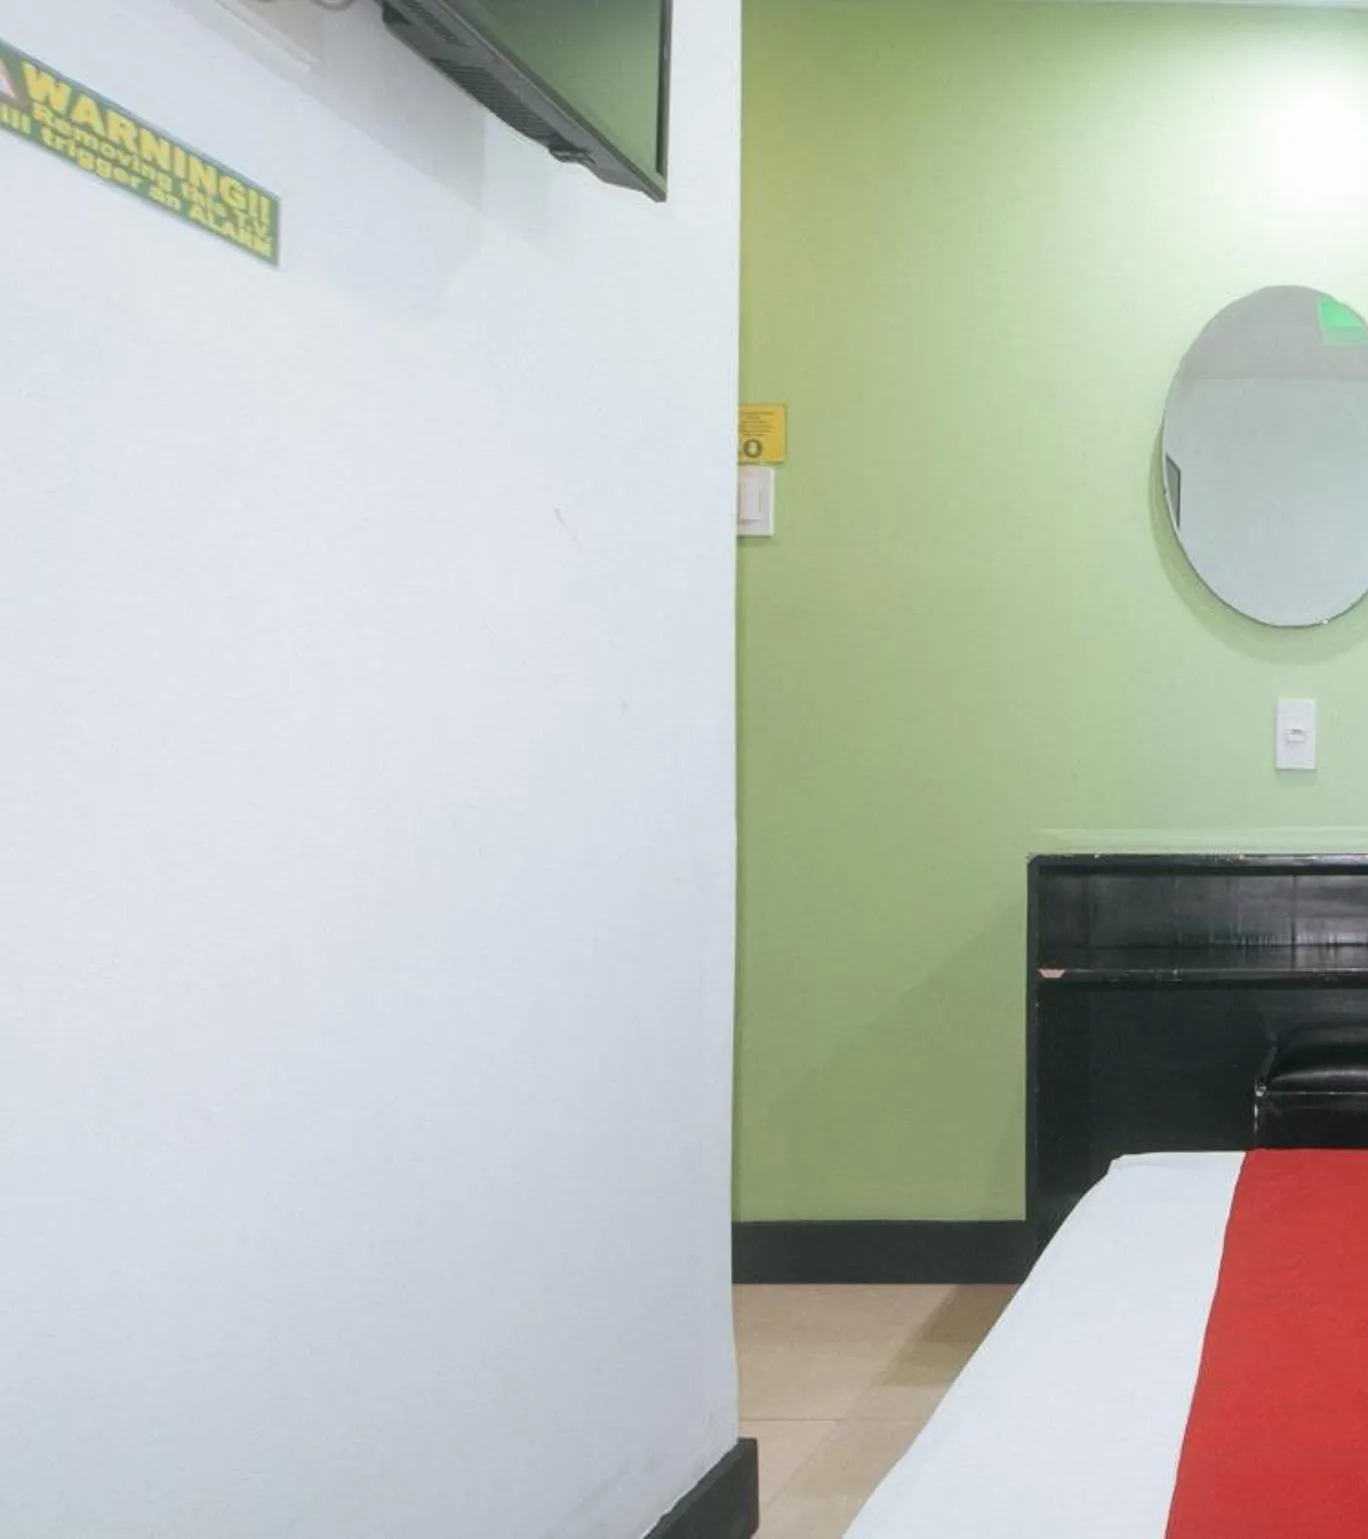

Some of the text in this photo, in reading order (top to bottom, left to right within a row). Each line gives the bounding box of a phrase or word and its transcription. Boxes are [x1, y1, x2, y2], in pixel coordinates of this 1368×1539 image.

[21, 60, 270, 225] WARNING!!
[32, 102, 172, 191] Removing
[188, 204, 272, 257] ALARM
